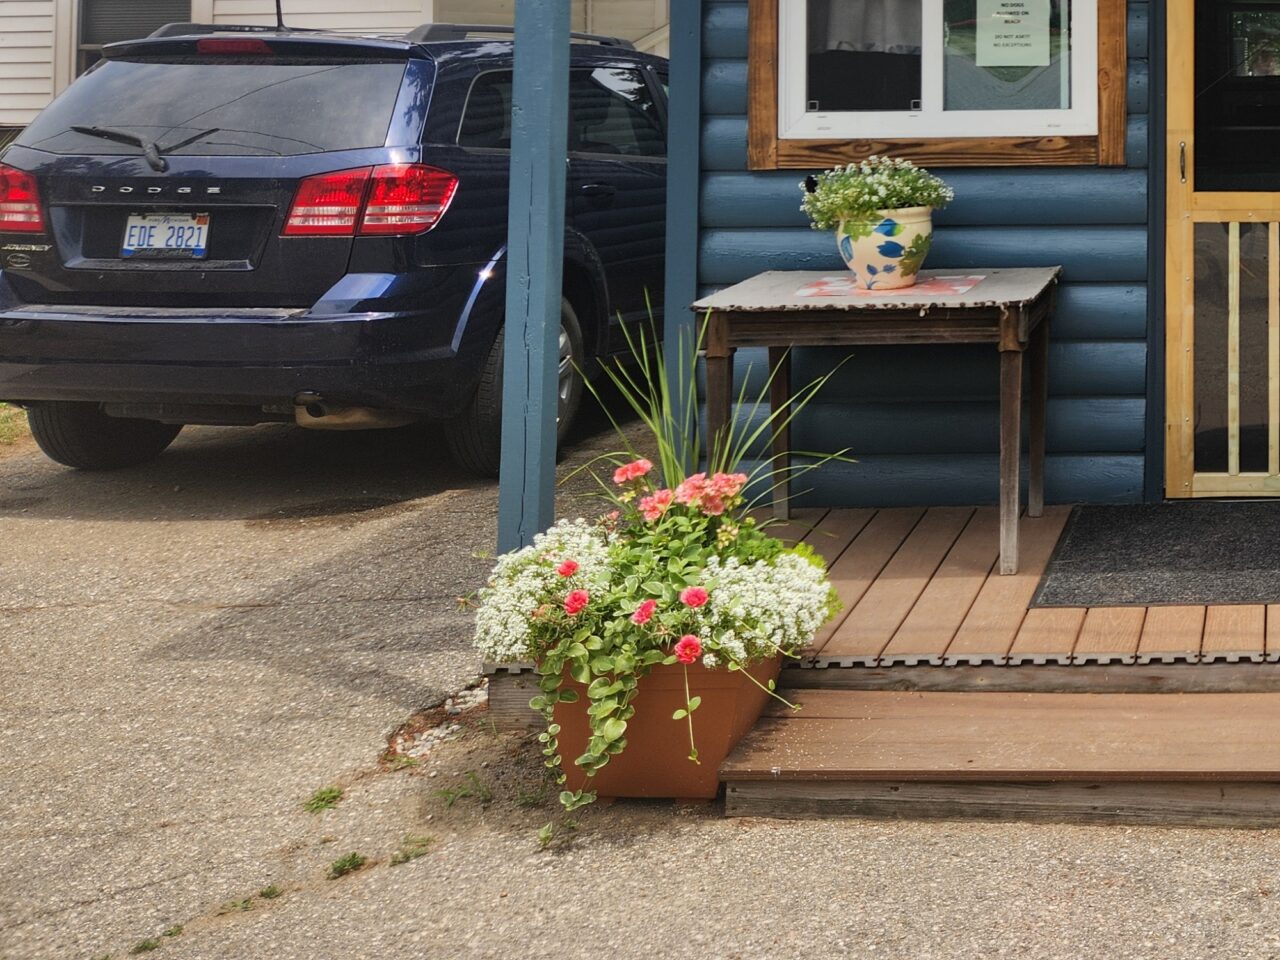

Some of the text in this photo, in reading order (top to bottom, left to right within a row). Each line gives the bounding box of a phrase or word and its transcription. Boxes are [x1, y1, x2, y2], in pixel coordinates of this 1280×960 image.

[91, 185, 220, 194] DODGE
[127, 226, 203, 248] EDE 2821
